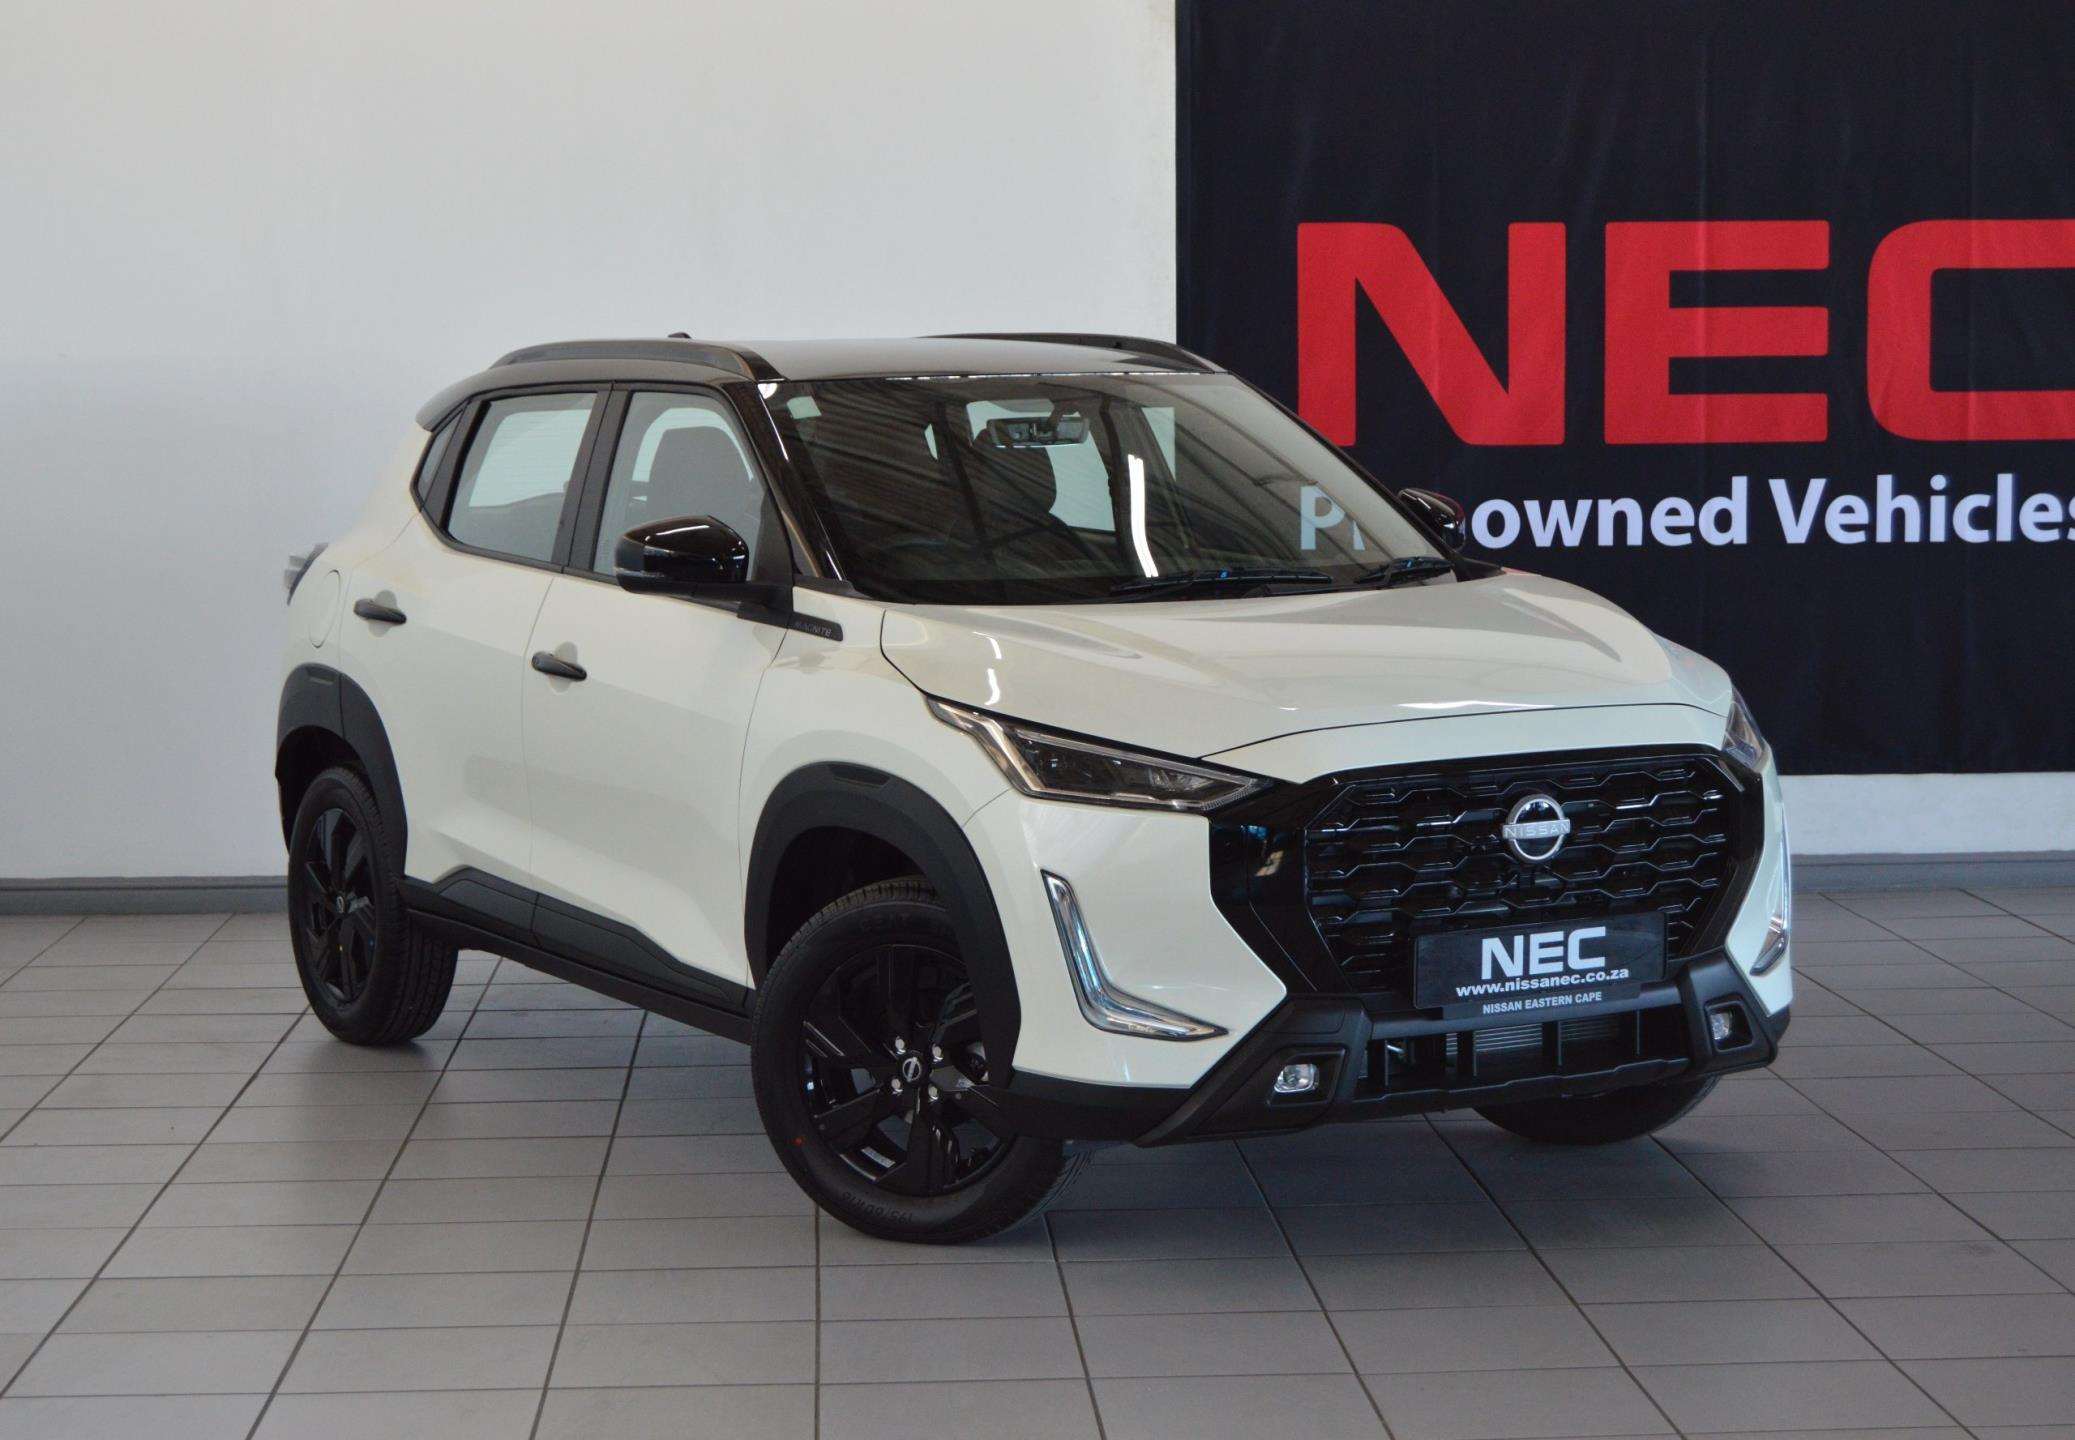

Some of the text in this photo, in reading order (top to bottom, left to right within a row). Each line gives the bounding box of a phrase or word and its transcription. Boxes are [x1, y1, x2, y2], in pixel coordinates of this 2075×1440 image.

[1297, 219, 2075, 446] NEC
[1769, 473, 2075, 544] Vehicle
[1504, 822, 1569, 838] NISSAN
[1481, 926, 1606, 980] NEC
[1455, 968, 1630, 997] www.nissanec.co.za
[1482, 991, 1602, 1015] NISSAN EASTERN CAPE
